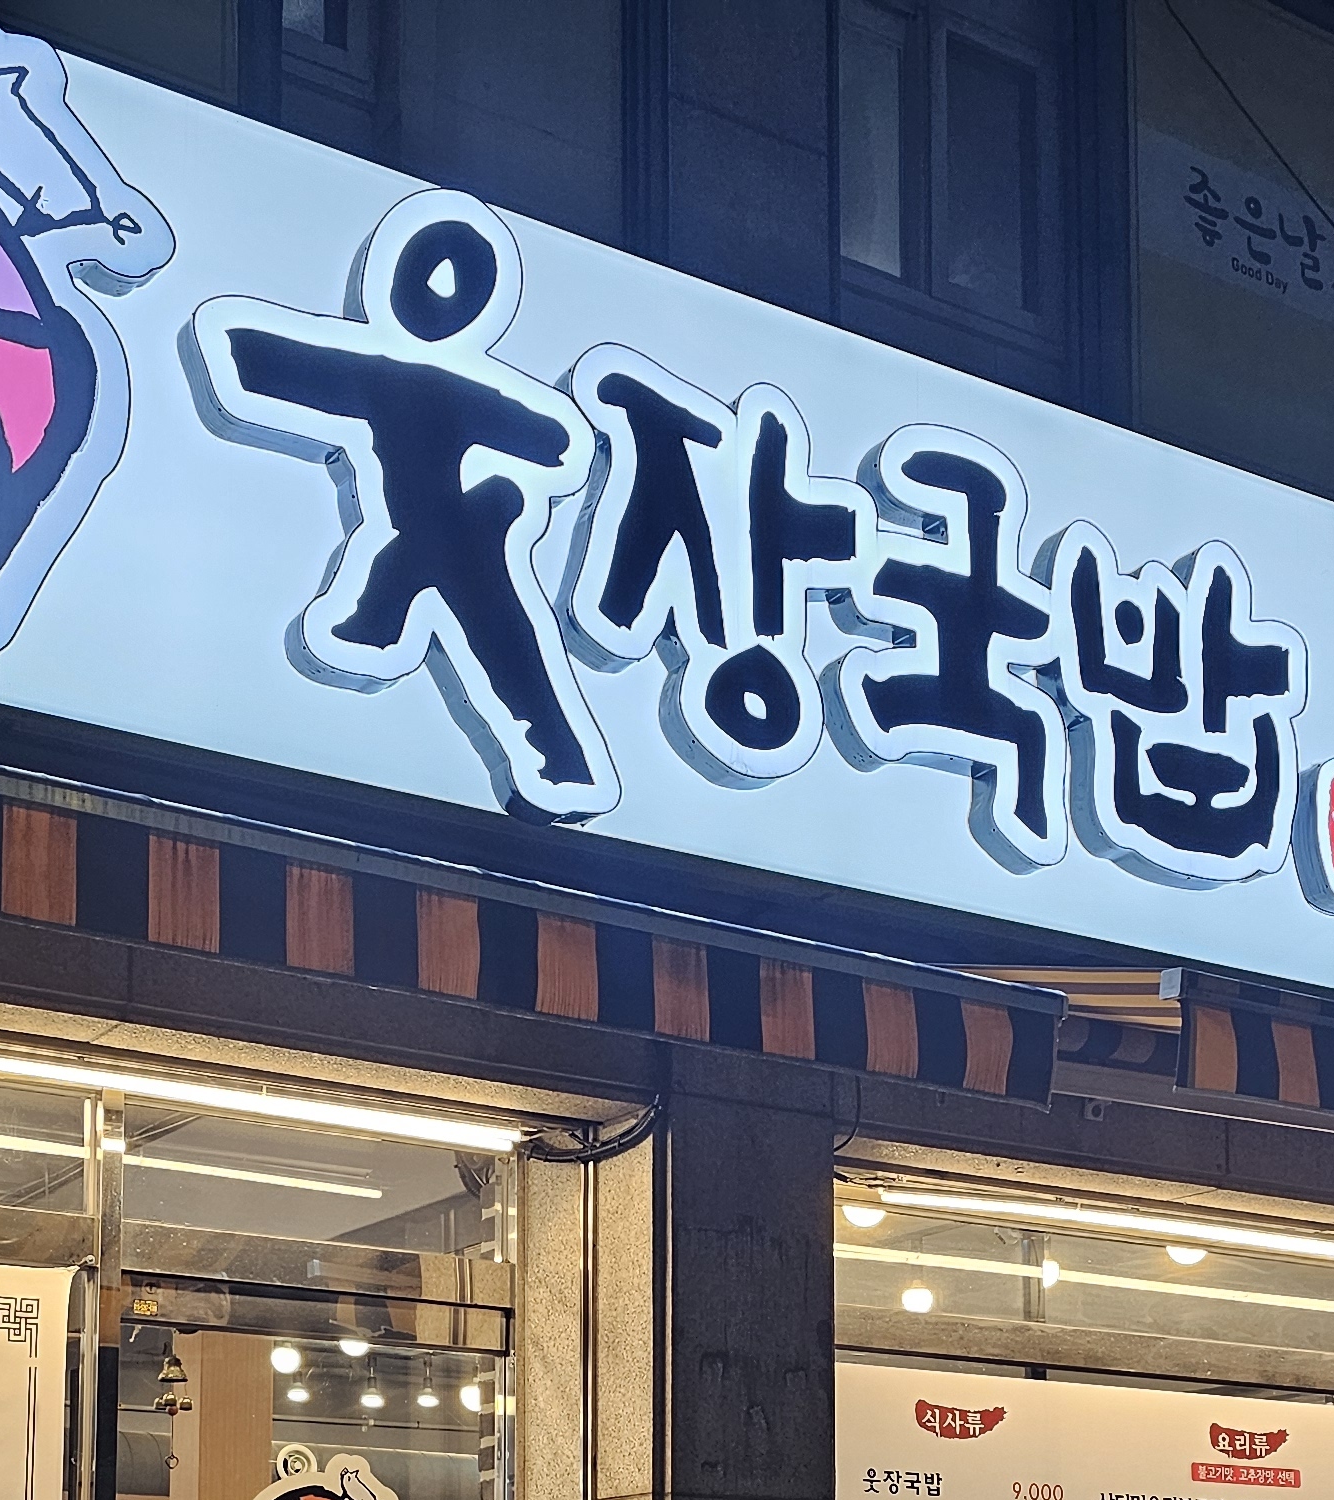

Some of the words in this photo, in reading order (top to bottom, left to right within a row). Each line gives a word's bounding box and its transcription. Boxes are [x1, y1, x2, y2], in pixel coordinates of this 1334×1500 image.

[1183, 167, 1327, 291] 좋은날
[1231, 257, 1263, 282] Good
[1265, 270, 1289, 295] Day
[227, 220, 1291, 855] 웃장국밥
[921, 1407, 985, 1437] 식사류
[1214, 1432, 1271, 1458] 요리류
[862, 1467, 943, 1497] 웃장국밥
[1197, 1465, 1237, 1482] 불고기맛,
[1238, 1468, 1275, 1484] 고추장맛
[1276, 1470, 1295, 1486] 선택
